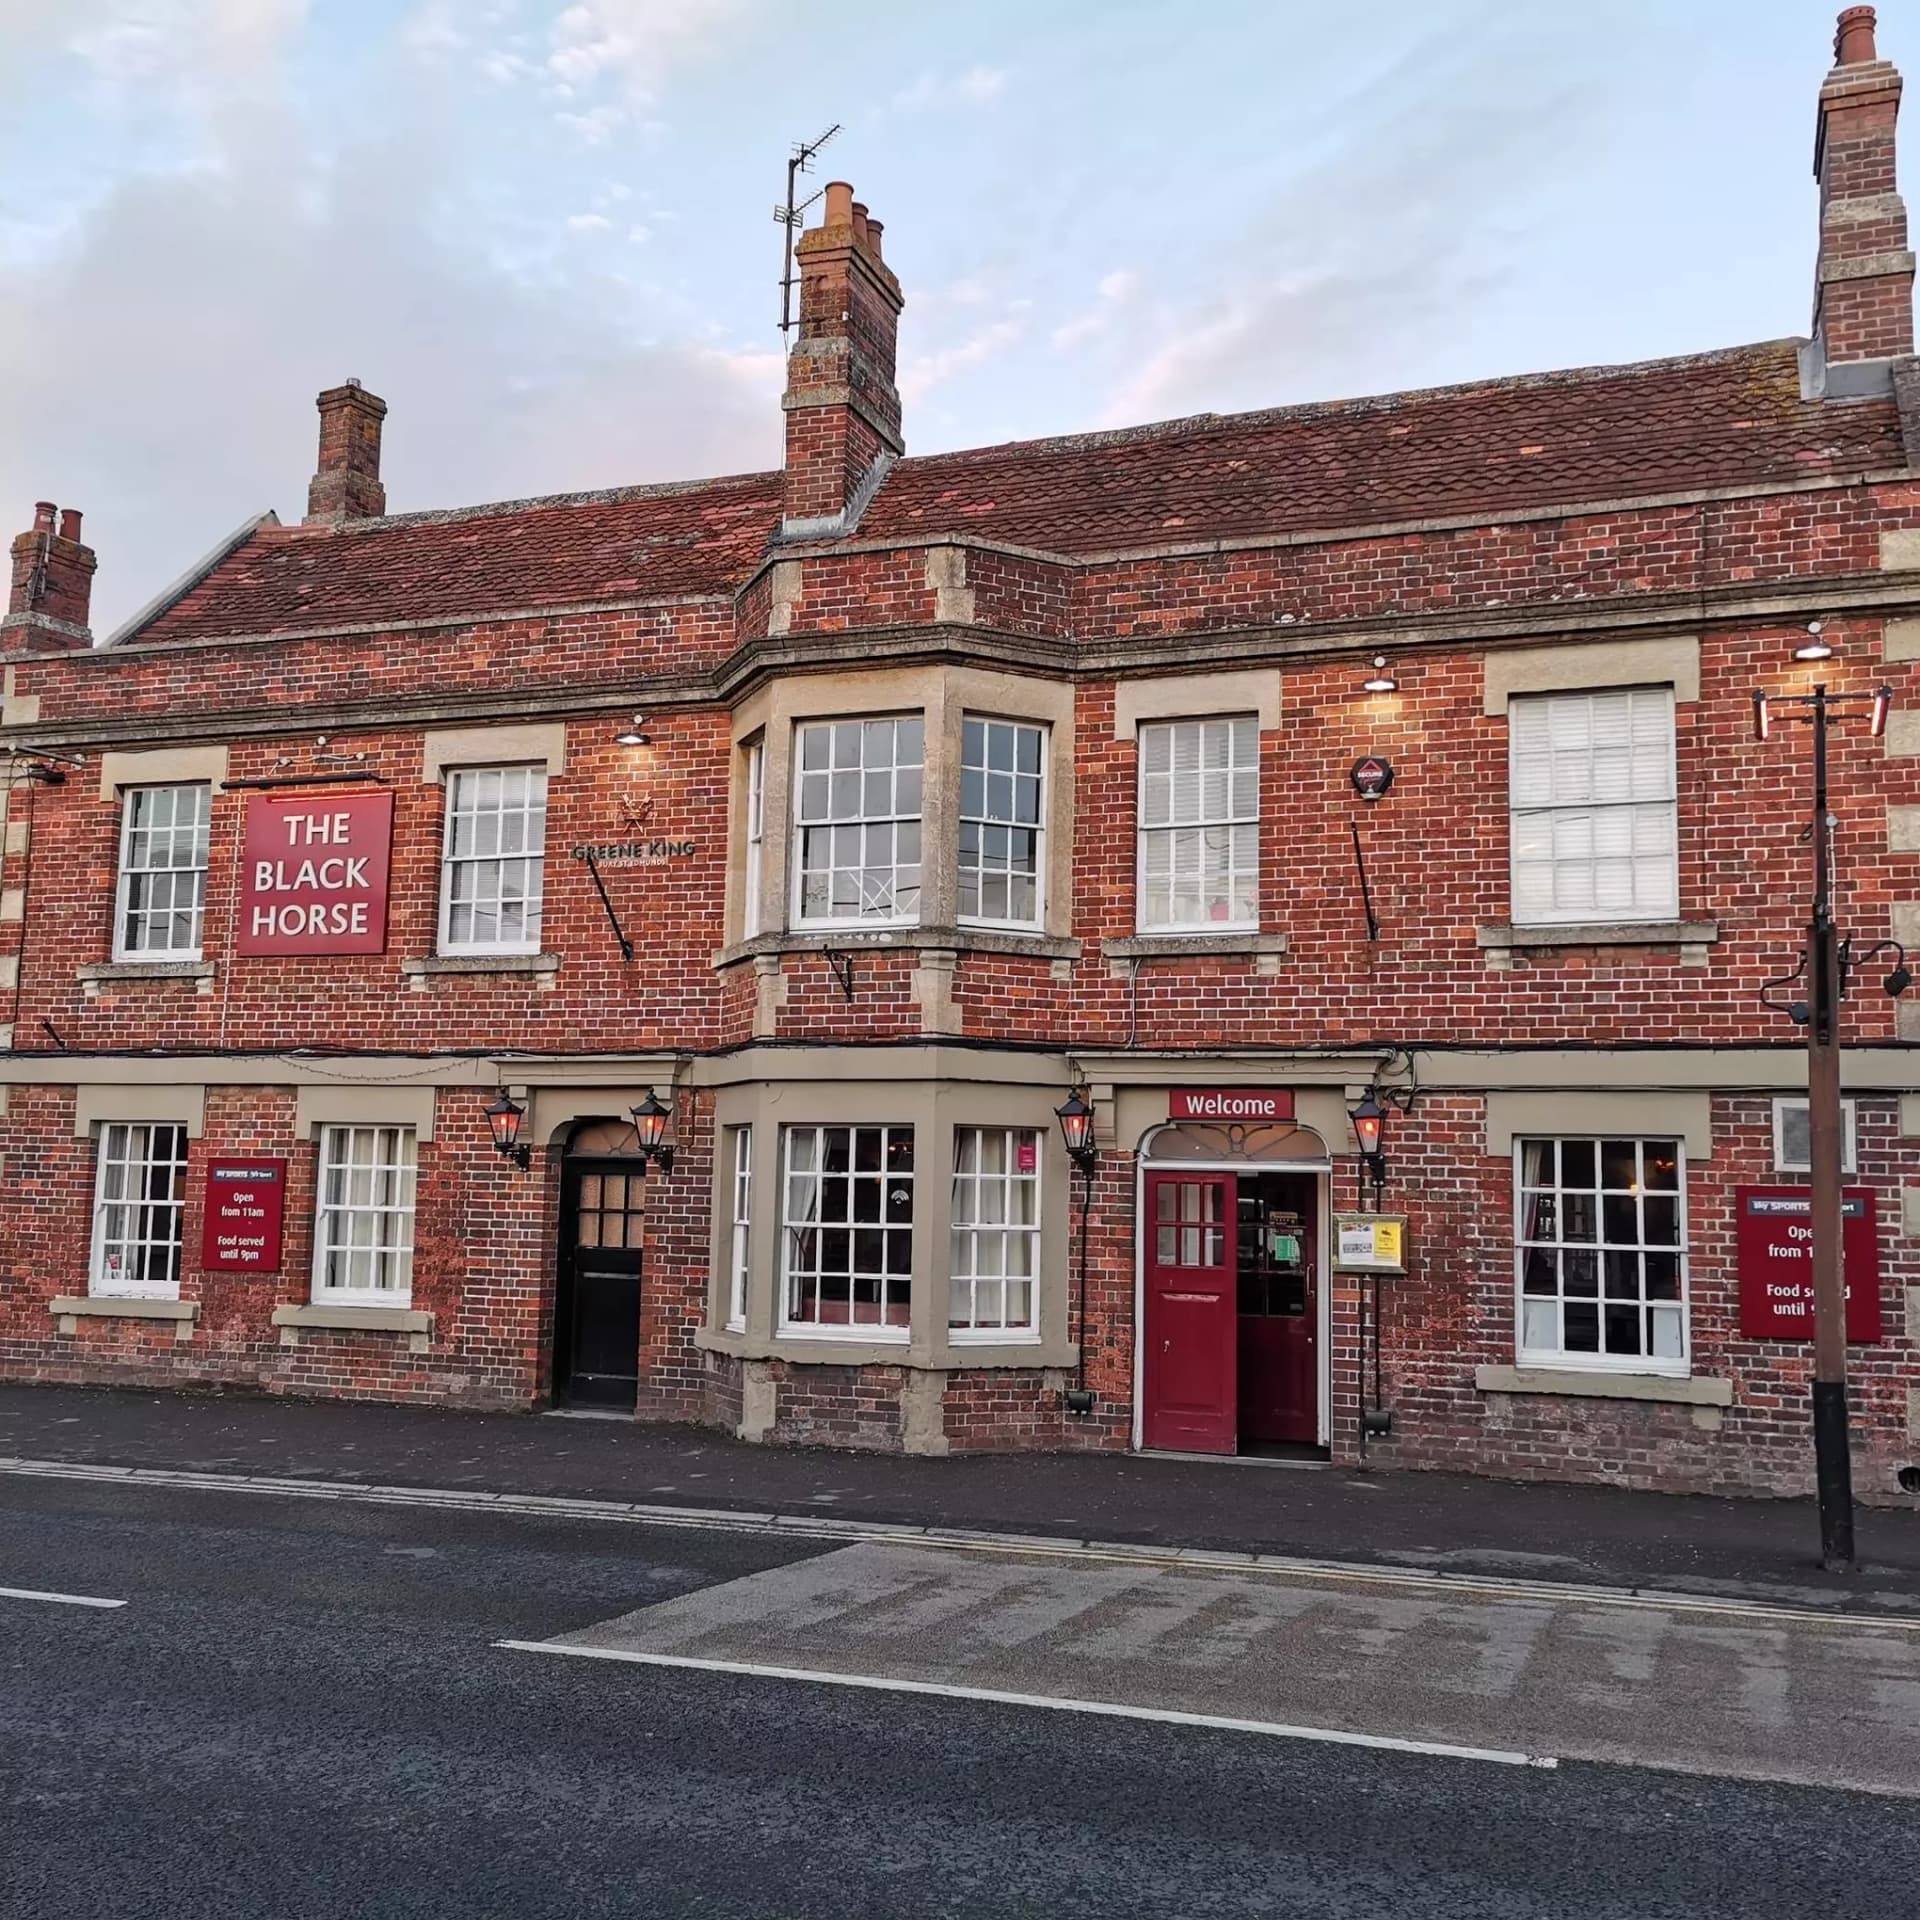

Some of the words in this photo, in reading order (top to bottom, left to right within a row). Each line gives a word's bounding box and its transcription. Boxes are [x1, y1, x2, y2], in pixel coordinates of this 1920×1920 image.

[283, 813, 351, 846] THE
[573, 843, 642, 860] GREENE
[648, 841, 696, 857] KING
[254, 857, 370, 892] BLACK
[252, 902, 369, 937] HORSE
[1186, 1093, 1276, 1115] Welcome
[233, 1192, 254, 1204] Open
[221, 1206, 240, 1217] from
[243, 1207, 264, 1217] 11am
[1771, 1201, 1811, 1211] SPORTS
[1788, 1225, 1813, 1241] Ope
[217, 1235, 237, 1246] Food
[238, 1236, 265, 1247] served
[220, 1248, 238, 1259] until
[241, 1249, 259, 1261] 9pm
[1768, 1243, 1802, 1258] from
[1766, 1284, 1800, 1297] Food
[1773, 1302, 1805, 1316] until
